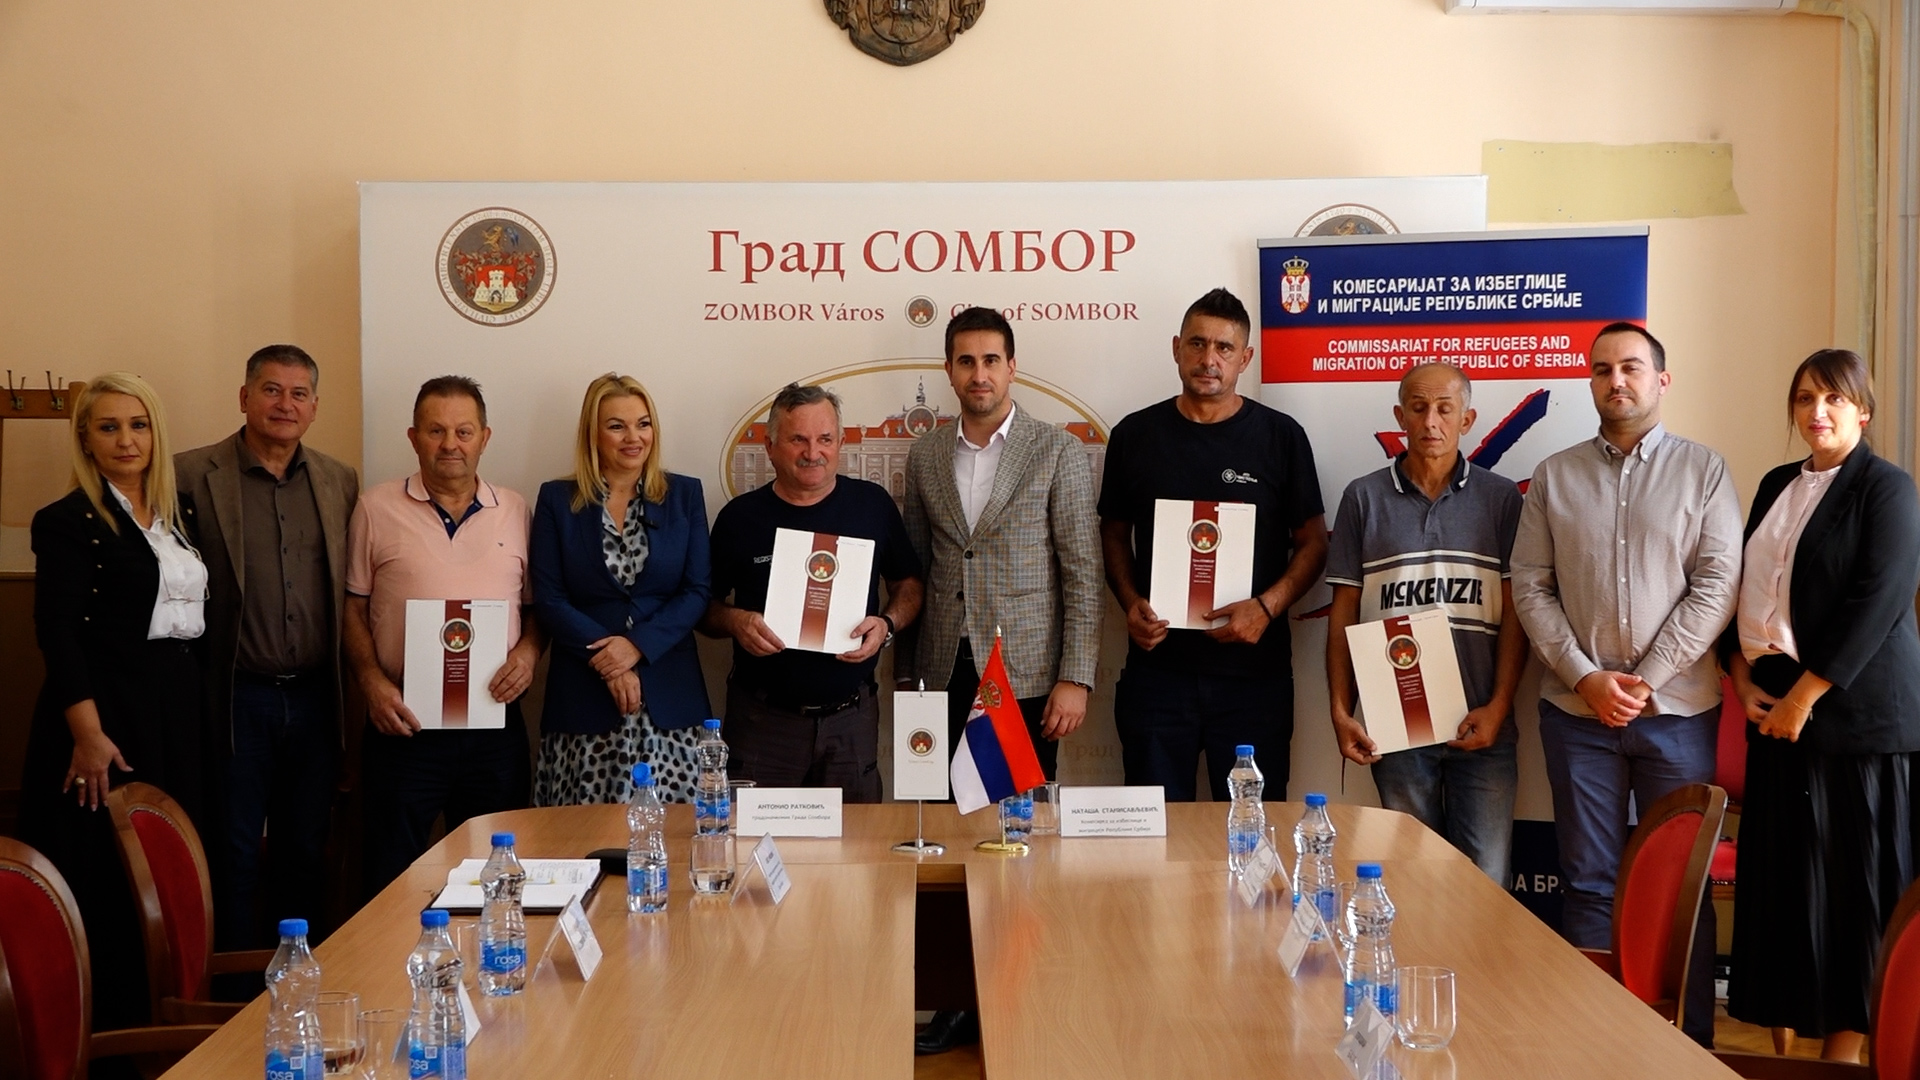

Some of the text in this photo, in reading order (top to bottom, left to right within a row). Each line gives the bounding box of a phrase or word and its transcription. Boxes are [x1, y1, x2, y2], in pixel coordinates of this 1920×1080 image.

[708, 229, 1136, 284] Град СОМБОР
[1333, 273, 1567, 295] КОМЕСАРИЈАТ ЗА ИЗБЕГЛИЦЕ
[704, 302, 885, 322] ZOMBOR Város
[1002, 303, 1026, 321] of
[1031, 303, 1140, 322] SOMBOR
[1318, 293, 1582, 315] И МИГРАЦИЈЕ РЕПУБЛИКЕ СРБИЈЕ
[1328, 336, 1570, 354] COMMISSARIAT FOR REFUGEES AND
[1313, 357, 1386, 371] MIGRATION
[1390, 356, 1407, 369] OF
[1512, 354, 1531, 367] OF
[1534, 353, 1586, 367] SERBIA
[494, 955, 521, 965] rosa
